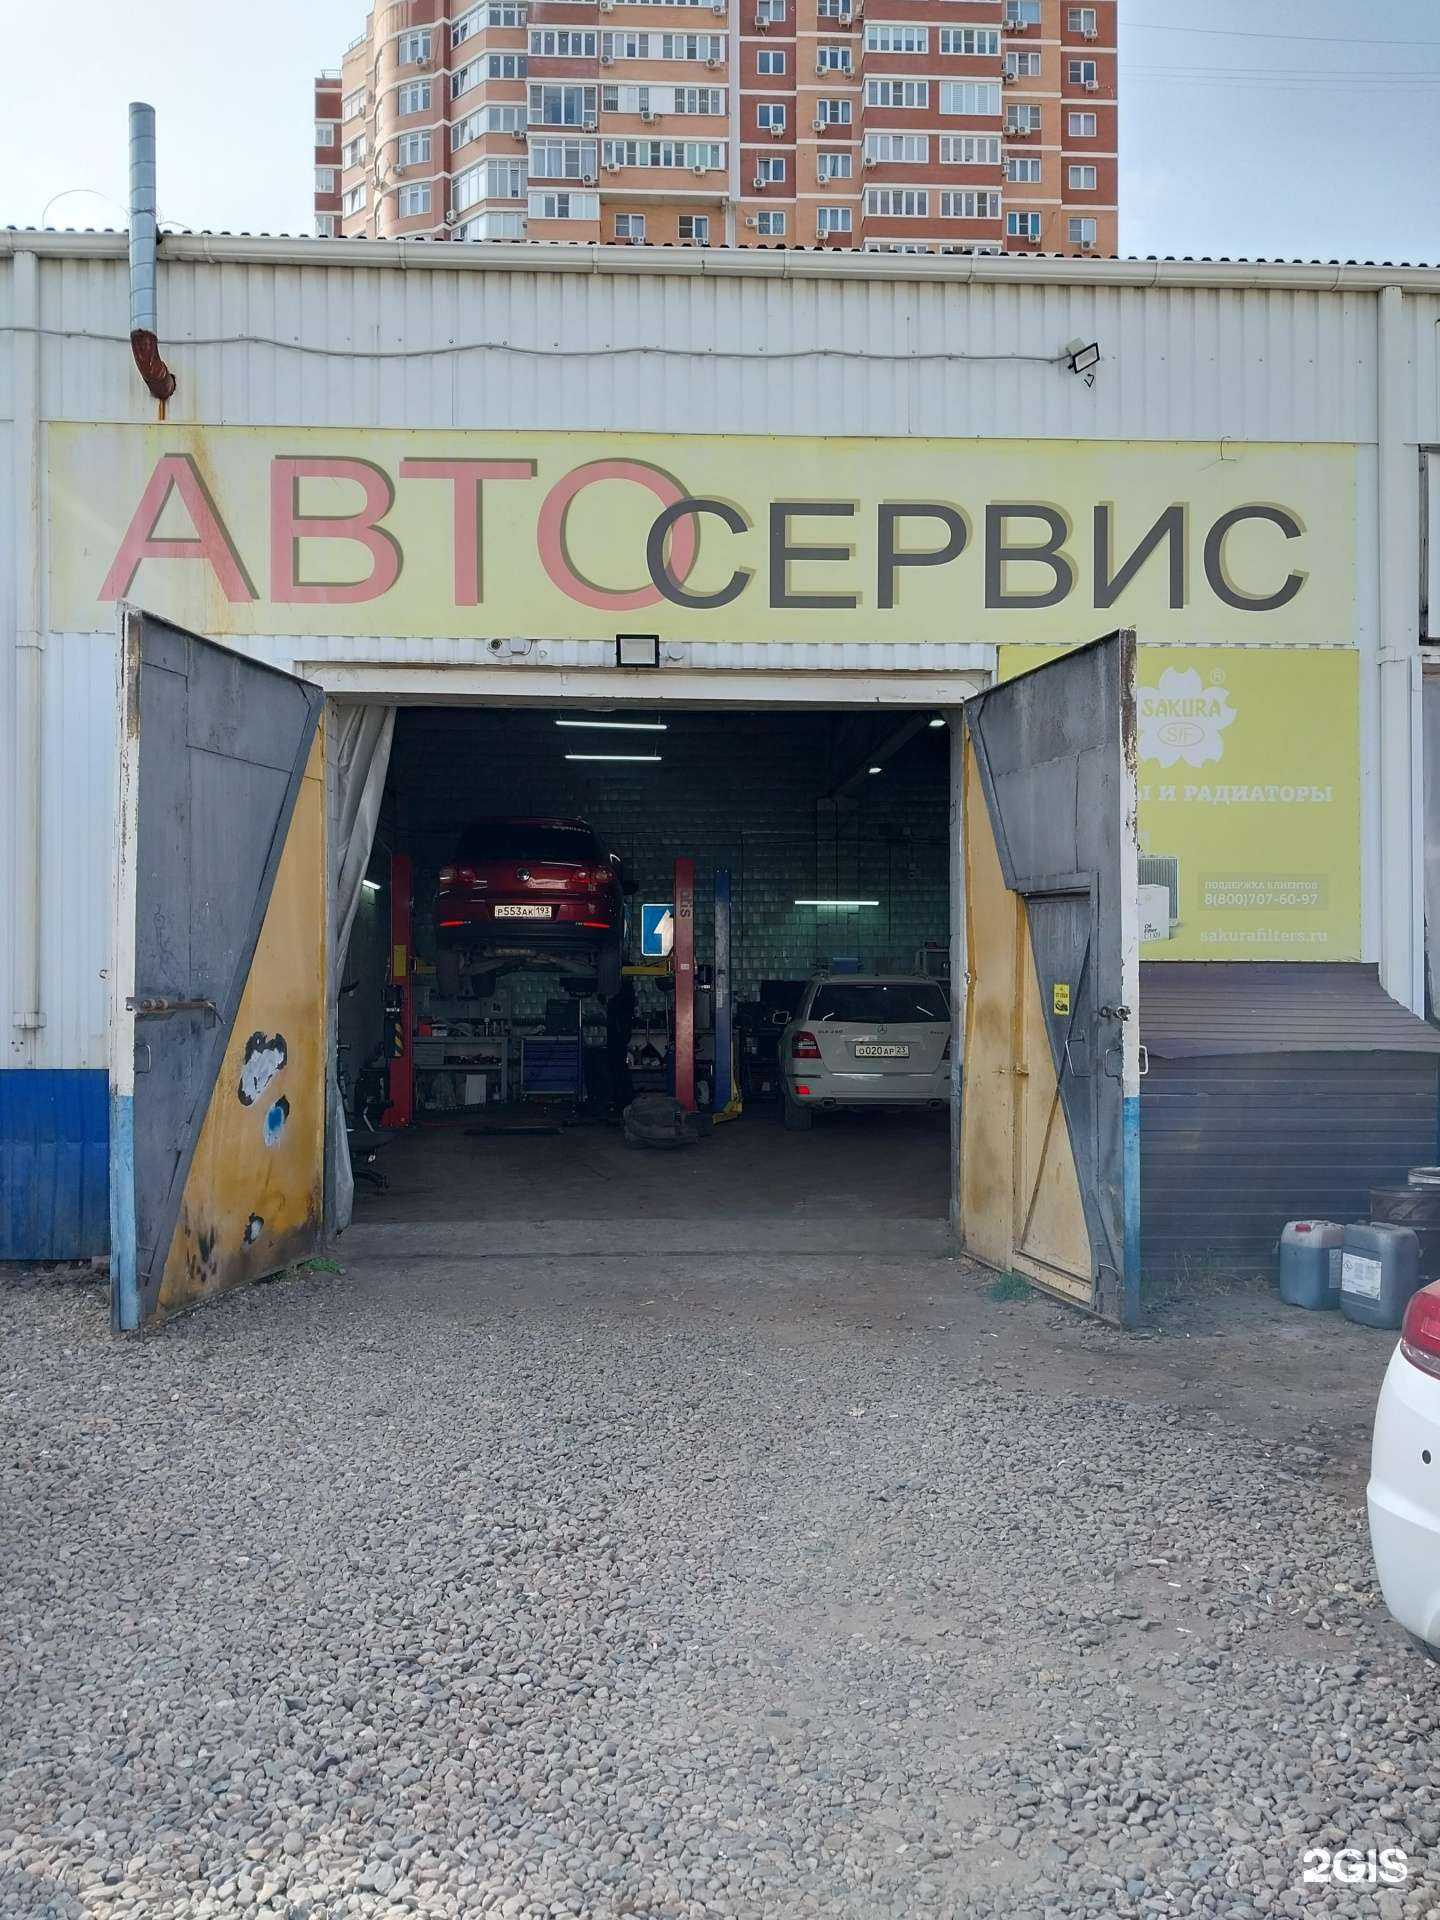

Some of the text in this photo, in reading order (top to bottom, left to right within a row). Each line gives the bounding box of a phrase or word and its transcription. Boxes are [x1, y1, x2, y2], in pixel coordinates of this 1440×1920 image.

[1142, 698, 1221, 717] SAKURA
[1158, 785, 1176, 801] И
[1184, 785, 1333, 805] РАДИАТОРЫ
[1204, 893, 1318, 907] 8(800)707-60-97
[1200, 928, 1327, 943] sakurafilters.ru
